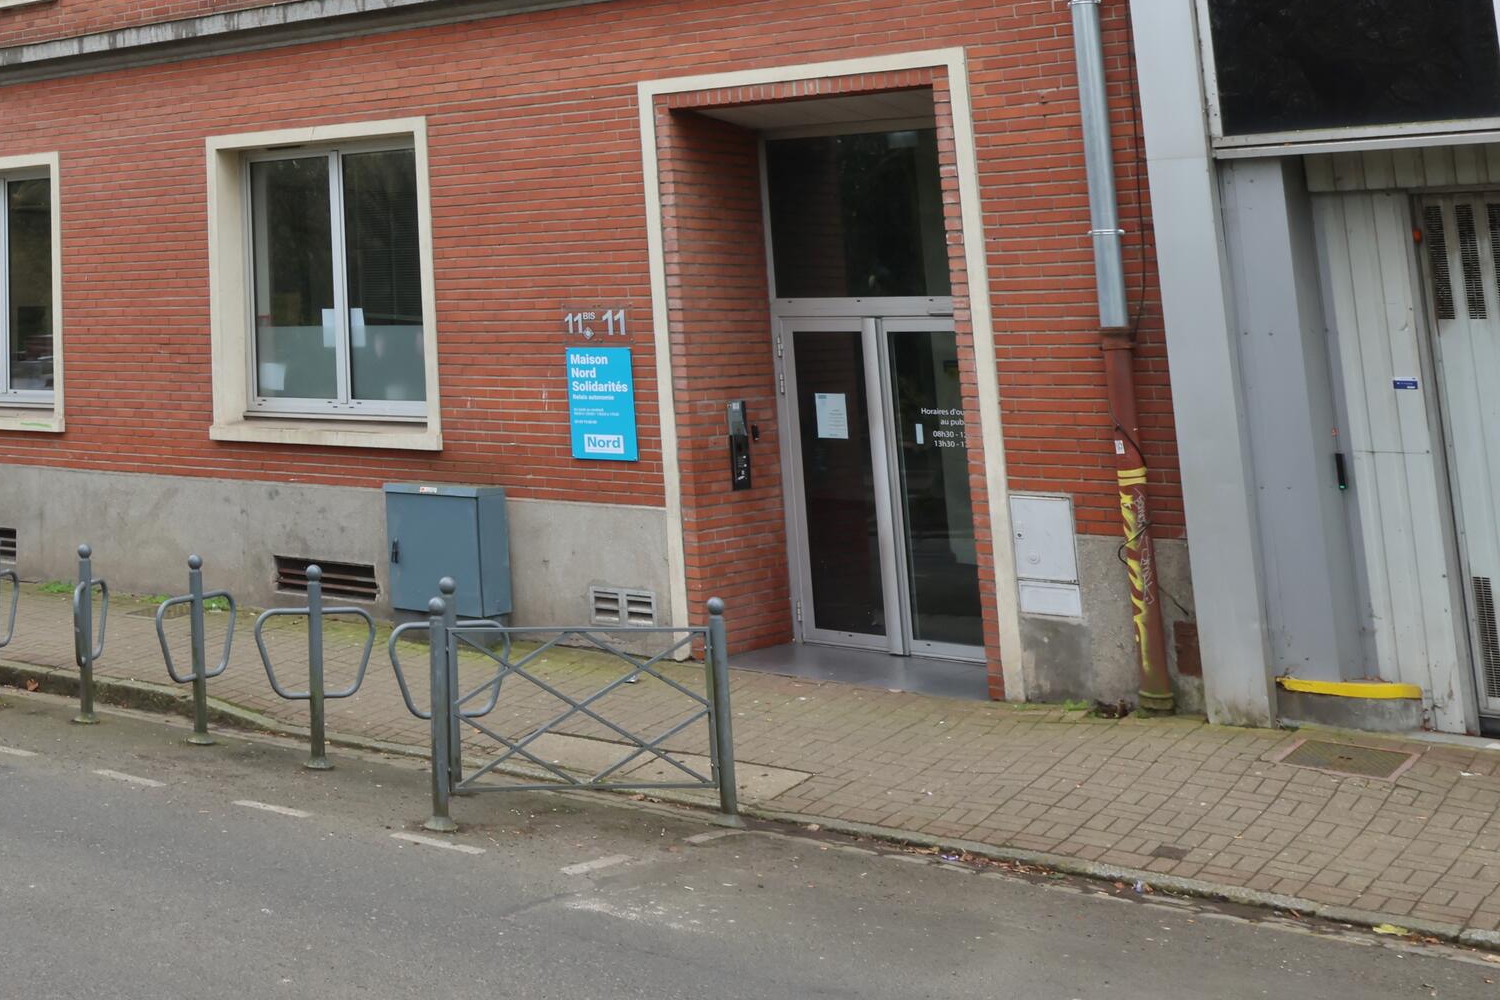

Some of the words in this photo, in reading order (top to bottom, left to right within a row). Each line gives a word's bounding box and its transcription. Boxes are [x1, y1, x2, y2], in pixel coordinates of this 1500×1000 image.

[564, 312, 583, 335] 11
[583, 312, 596, 320] BIS
[602, 309, 626, 336] 11
[570, 354, 608, 365] Maison
[571, 368, 597, 378] Nord
[572, 381, 628, 392] Solidarités
[932, 430, 954, 438] 08h30
[587, 436, 621, 449] Nord
